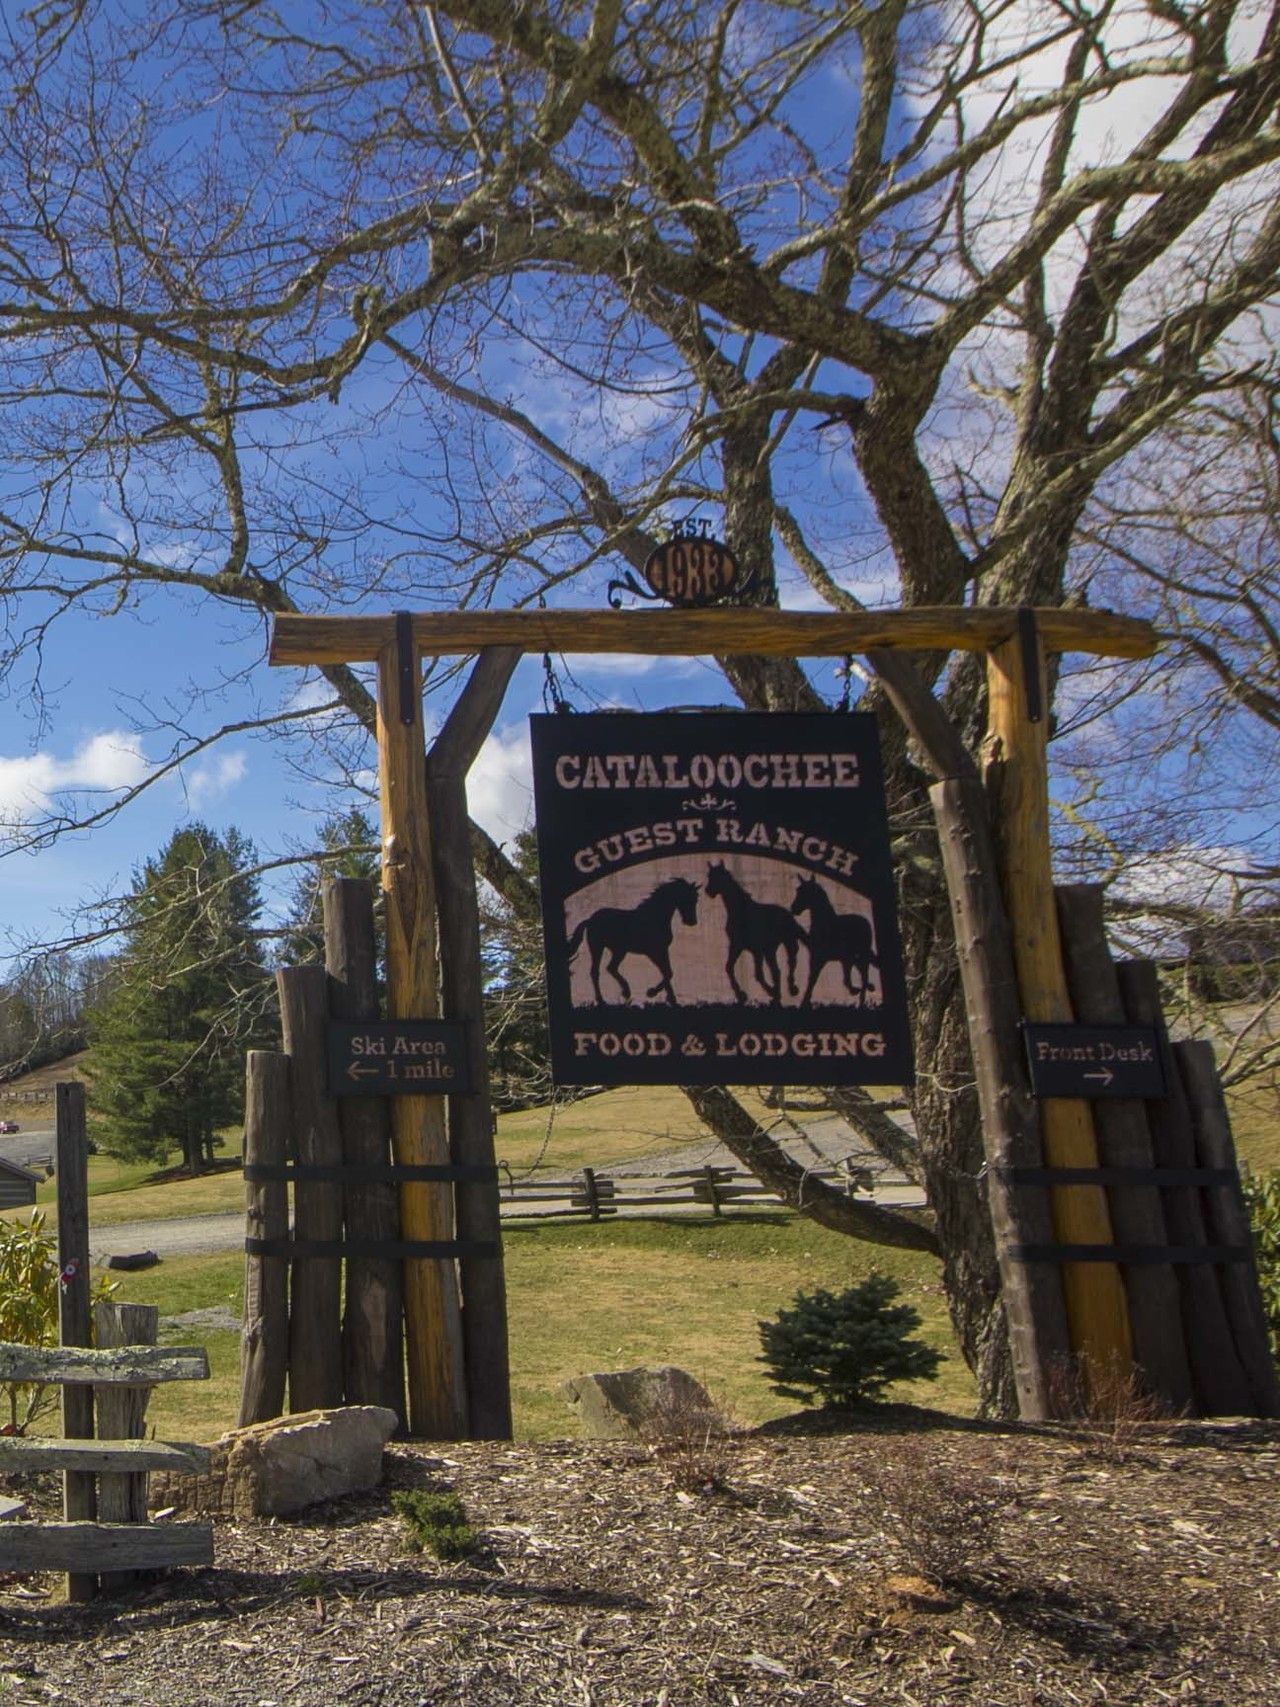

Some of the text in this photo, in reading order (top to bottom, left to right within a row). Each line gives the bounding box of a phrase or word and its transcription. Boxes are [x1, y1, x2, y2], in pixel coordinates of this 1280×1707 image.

[672, 518, 716, 540] EST.
[555, 754, 860, 789] CATALOOCHEE
[574, 818, 860, 877] GUEST RANCH
[351, 1035, 446, 1055] Ski Area
[573, 1032, 887, 1057] FOOD & LODGING
[1036, 1040, 1153, 1061] Front Desk
[386, 1058, 455, 1079] 1 mile
